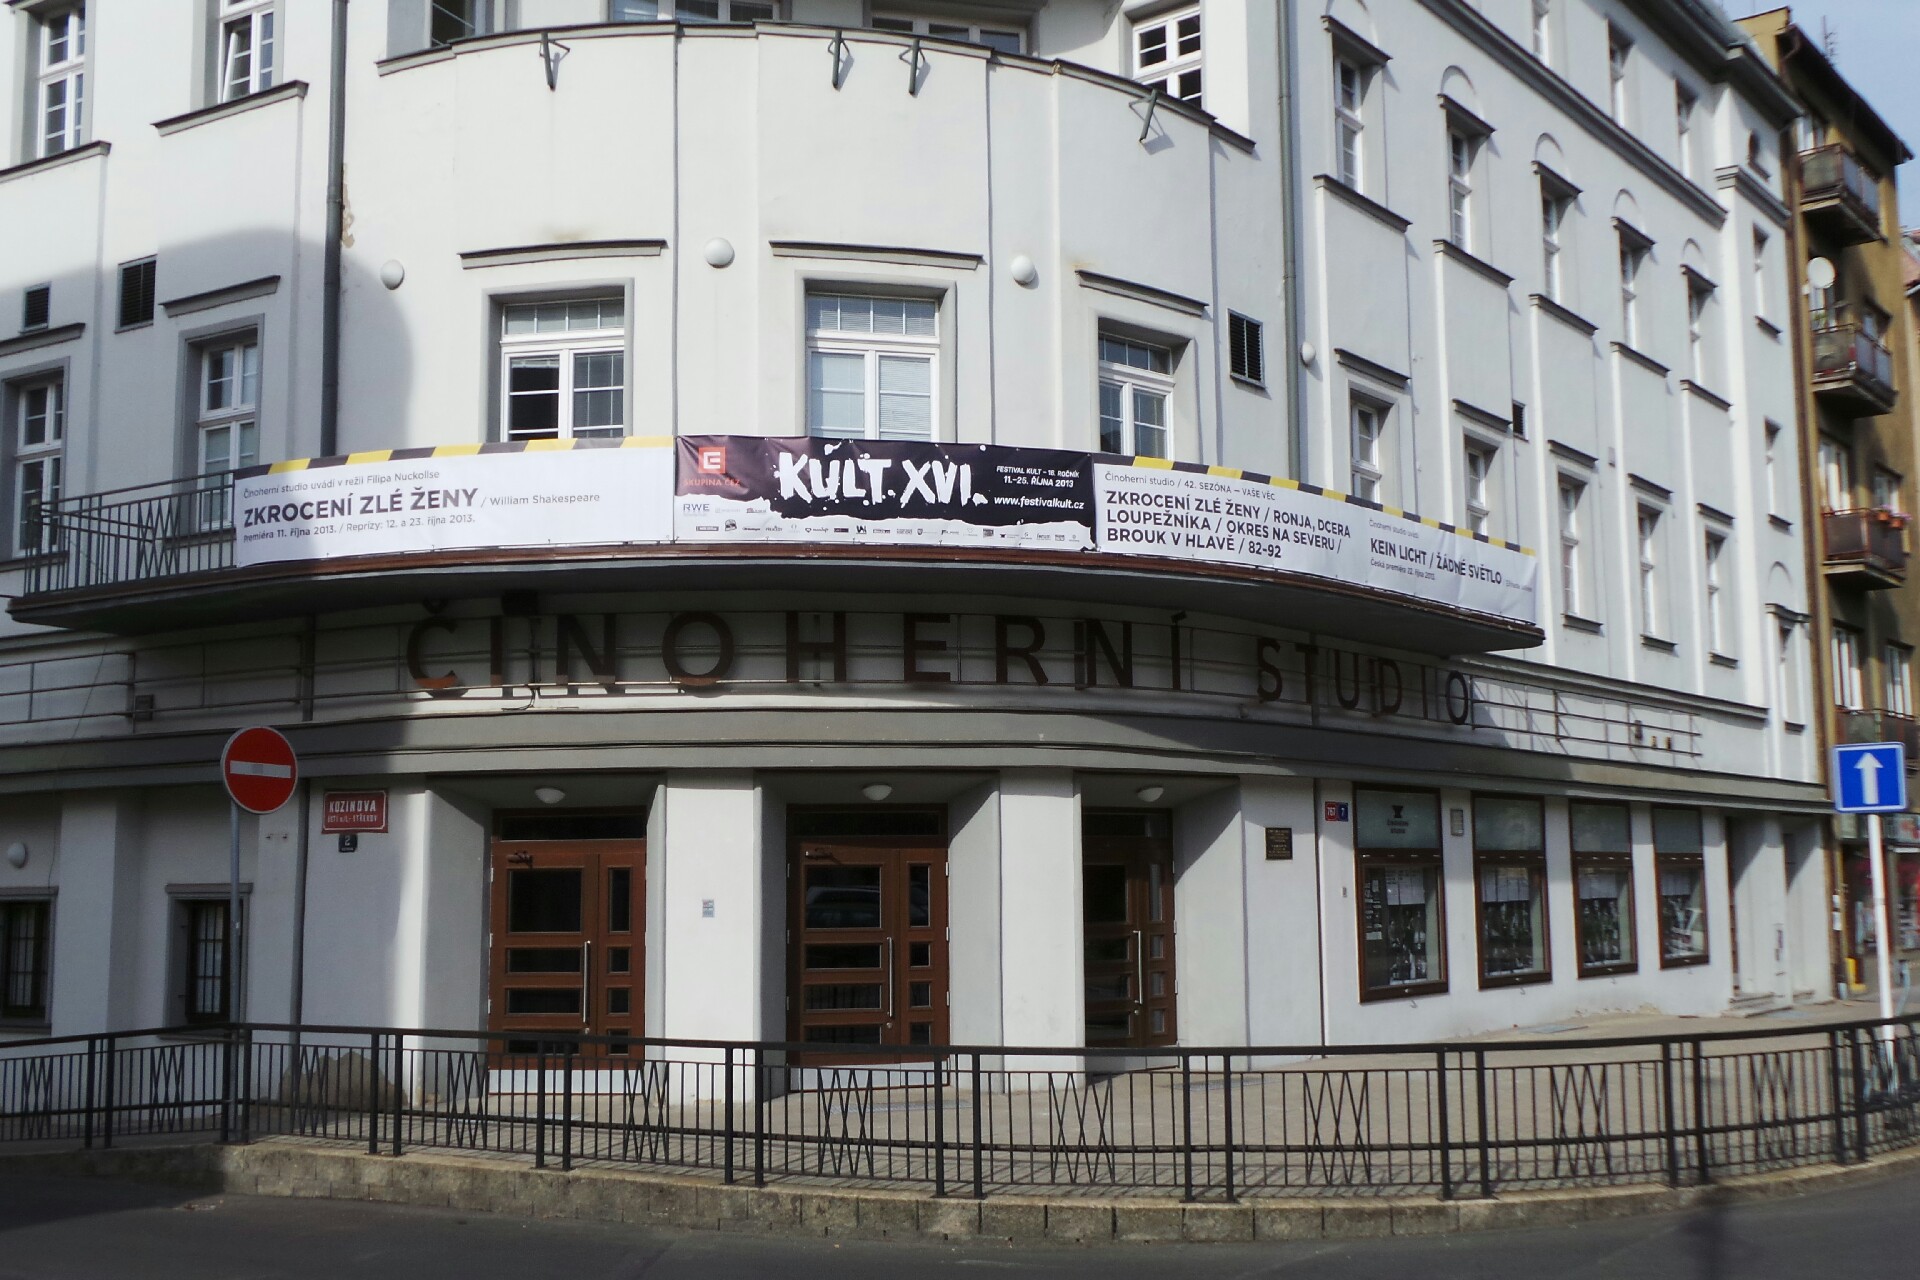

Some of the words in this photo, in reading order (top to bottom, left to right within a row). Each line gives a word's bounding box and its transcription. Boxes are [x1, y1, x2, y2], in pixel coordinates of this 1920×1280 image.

[243, 487, 279, 499] Činoherní
[281, 484, 307, 493] studio
[311, 481, 335, 490] uvádí
[345, 476, 364, 486] režii
[366, 474, 392, 486] Filipa
[394, 470, 440, 481] Nuckollse
[683, 479, 722, 487] SKUPINA
[996, 465, 1025, 475] FESTIVAL
[1026, 467, 1042, 475] KULT
[1057, 469, 1080, 479] ROČNÍK
[1031, 476, 1054, 486] ŘÍJNA
[1055, 479, 1074, 488] 2013
[1105, 471, 1147, 484] Činoherní
[1149, 478, 1175, 487] studio
[1184, 480, 1197, 489] 42.
[1199, 481, 1232, 493] SEZÓNA
[1242, 486, 1260, 498] VAŠE
[1262, 489, 1276, 501] VĚC
[244, 493, 354, 528] ZKROCENÍ
[359, 487, 403, 515] ZLÉ
[410, 486, 479, 511] ŽENY
[489, 495, 529, 507] William
[532, 493, 601, 504] Shakespeare
[683, 503, 710, 512] RWE
[994, 495, 1085, 510] www.festivalkult.cz
[1106, 490, 1191, 511] ZKROCENÍ
[1194, 497, 1222, 514] ZLÉ
[1225, 498, 1261, 519] ŽENY
[1273, 509, 1315, 532] RONJA,
[1317, 518, 1351, 538] DCERA
[243, 531, 274, 543] Premiéra
[277, 529, 287, 537] 11.
[290, 527, 311, 539] října
[313, 525, 337, 535] 2013.
[346, 522, 384, 533] Reprízy:
[386, 520, 398, 529] 12.
[409, 517, 424, 526] 23.
[427, 516, 446, 527] října
[449, 515, 475, 524] 2013.
[1107, 509, 1211, 531] LOUPEŽNÍKA
[1226, 520, 1269, 538] OKRES
[1272, 527, 1290, 543] NA
[1293, 531, 1335, 551] SEVERU
[1107, 528, 1167, 545] BROUK
[1171, 532, 1181, 545] V
[1185, 534, 1235, 551] HLAVĚ
[1248, 540, 1282, 558] 82-92
[1370, 537, 1397, 559] KEIN
[1399, 544, 1427, 566] LICHT
[1436, 552, 1466, 576] ŽÁDNÉ
[1468, 563, 1502, 585] SVĚTLO
[407, 597, 1188, 690] ČINOHERNÍ
[1257, 637, 1469, 725] STUDIO
[329, 799, 377, 813] KOZINOVA
[344, 835, 351, 846] 2
